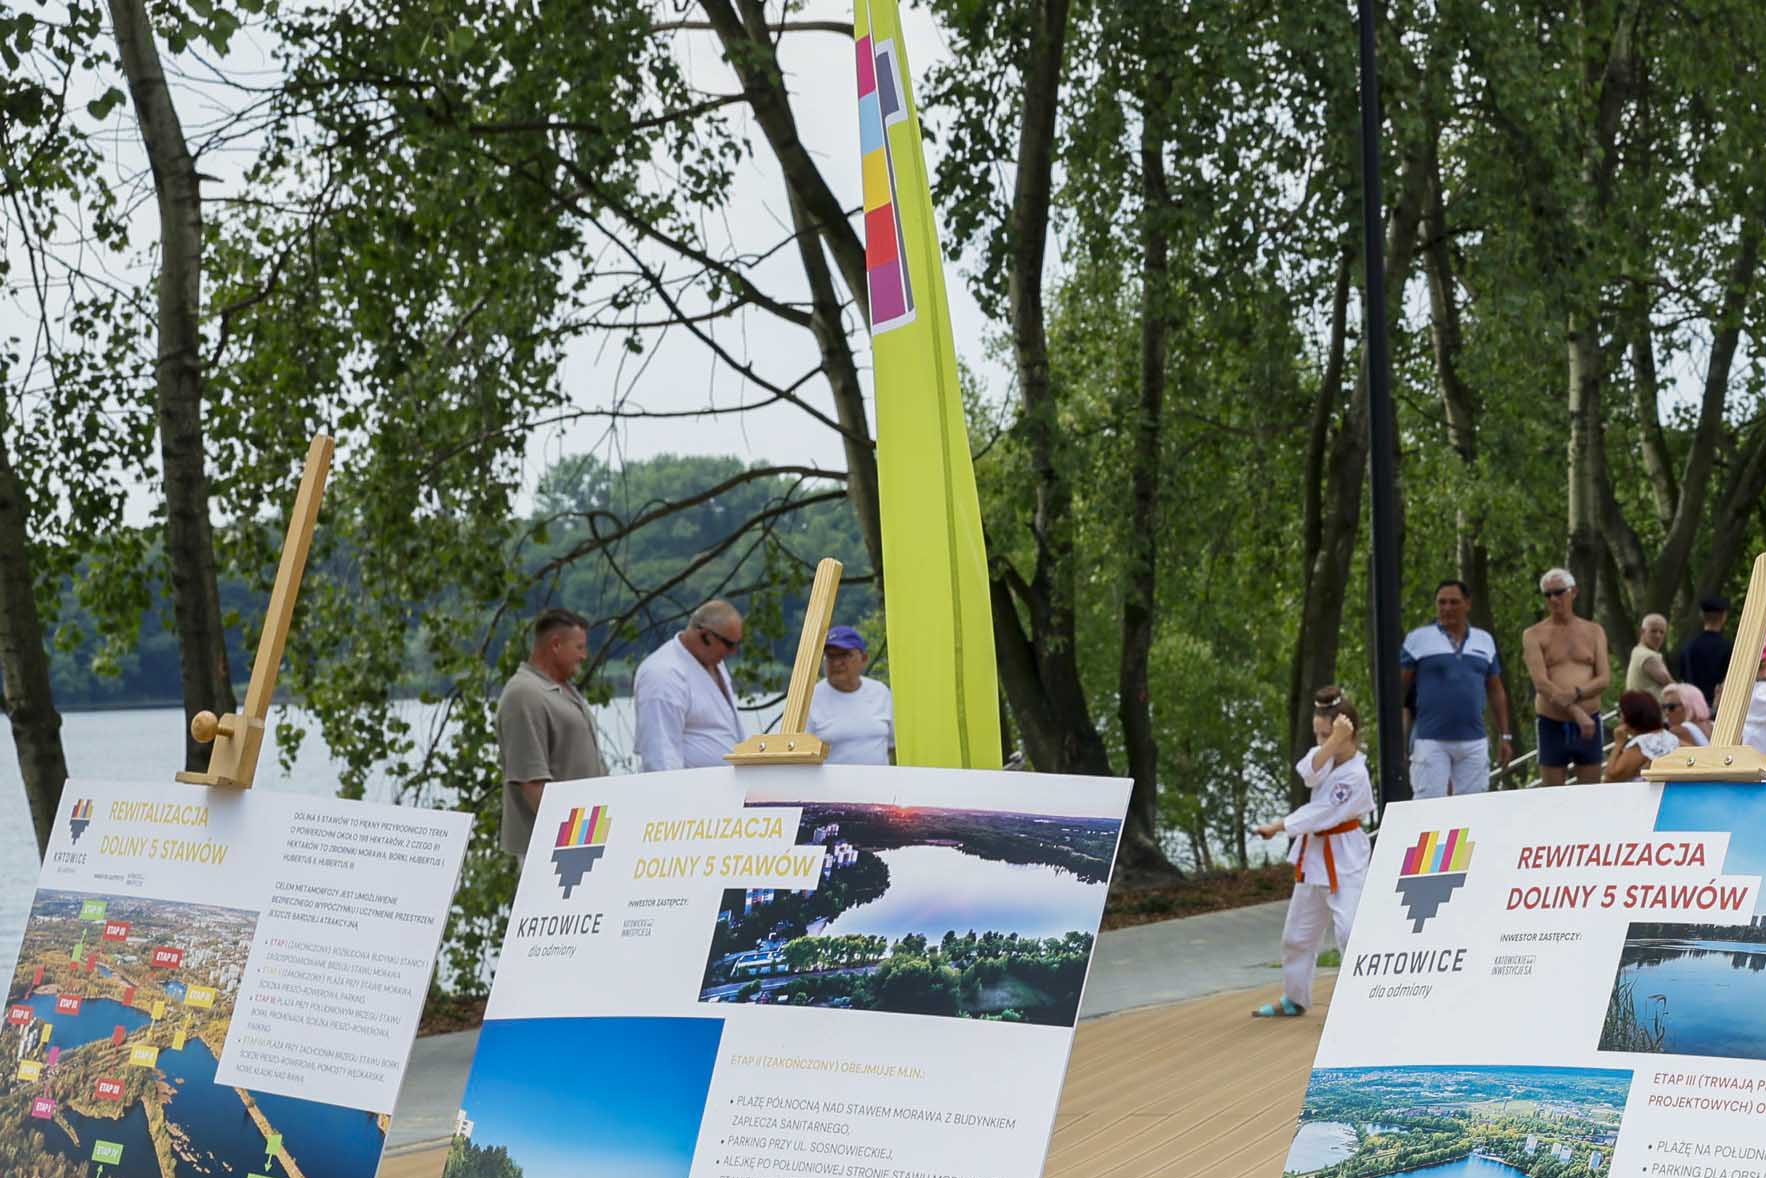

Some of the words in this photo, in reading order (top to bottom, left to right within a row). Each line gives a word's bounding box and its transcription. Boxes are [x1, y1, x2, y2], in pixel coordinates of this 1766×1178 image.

[110, 801, 209, 828] REWITALIZACJA
[643, 817, 783, 842] REWITALIZACJA
[54, 852, 88, 865] KATOWICE
[100, 835, 148, 858] DOLINY
[150, 839, 158, 859] 5
[160, 837, 228, 865] STAWÓW
[1517, 842, 1706, 870] REWITALIZACJA
[633, 856, 700, 880] DOLINY
[703, 856, 715, 877] 5
[720, 850, 816, 877] STAWÓW
[1506, 886, 1596, 911] DOLINY
[1600, 885, 1616, 910] 5
[1623, 879, 1748, 911] STAWÓW
[517, 913, 603, 938] KATOWICE
[1500, 933, 1538, 942] INWESTOR
[528, 944, 541, 958] dla
[542, 945, 576, 958] odmiany
[1353, 949, 1467, 977] KATOWICE
[1369, 984, 1385, 999] dla
[1387, 983, 1432, 999] odmiany
[1653, 1072, 1684, 1084] ETAP
[1685, 1074, 1696, 1086] III
[1698, 1073, 1753, 1093] (TRWAJĄ
[1647, 1094, 1753, 1114] PROJEKTOWYCH)
[1656, 1140, 1693, 1157] PLAŻĘ
[1693, 1143, 1711, 1155] NA
[1651, 1162, 1701, 1177] PARKING
